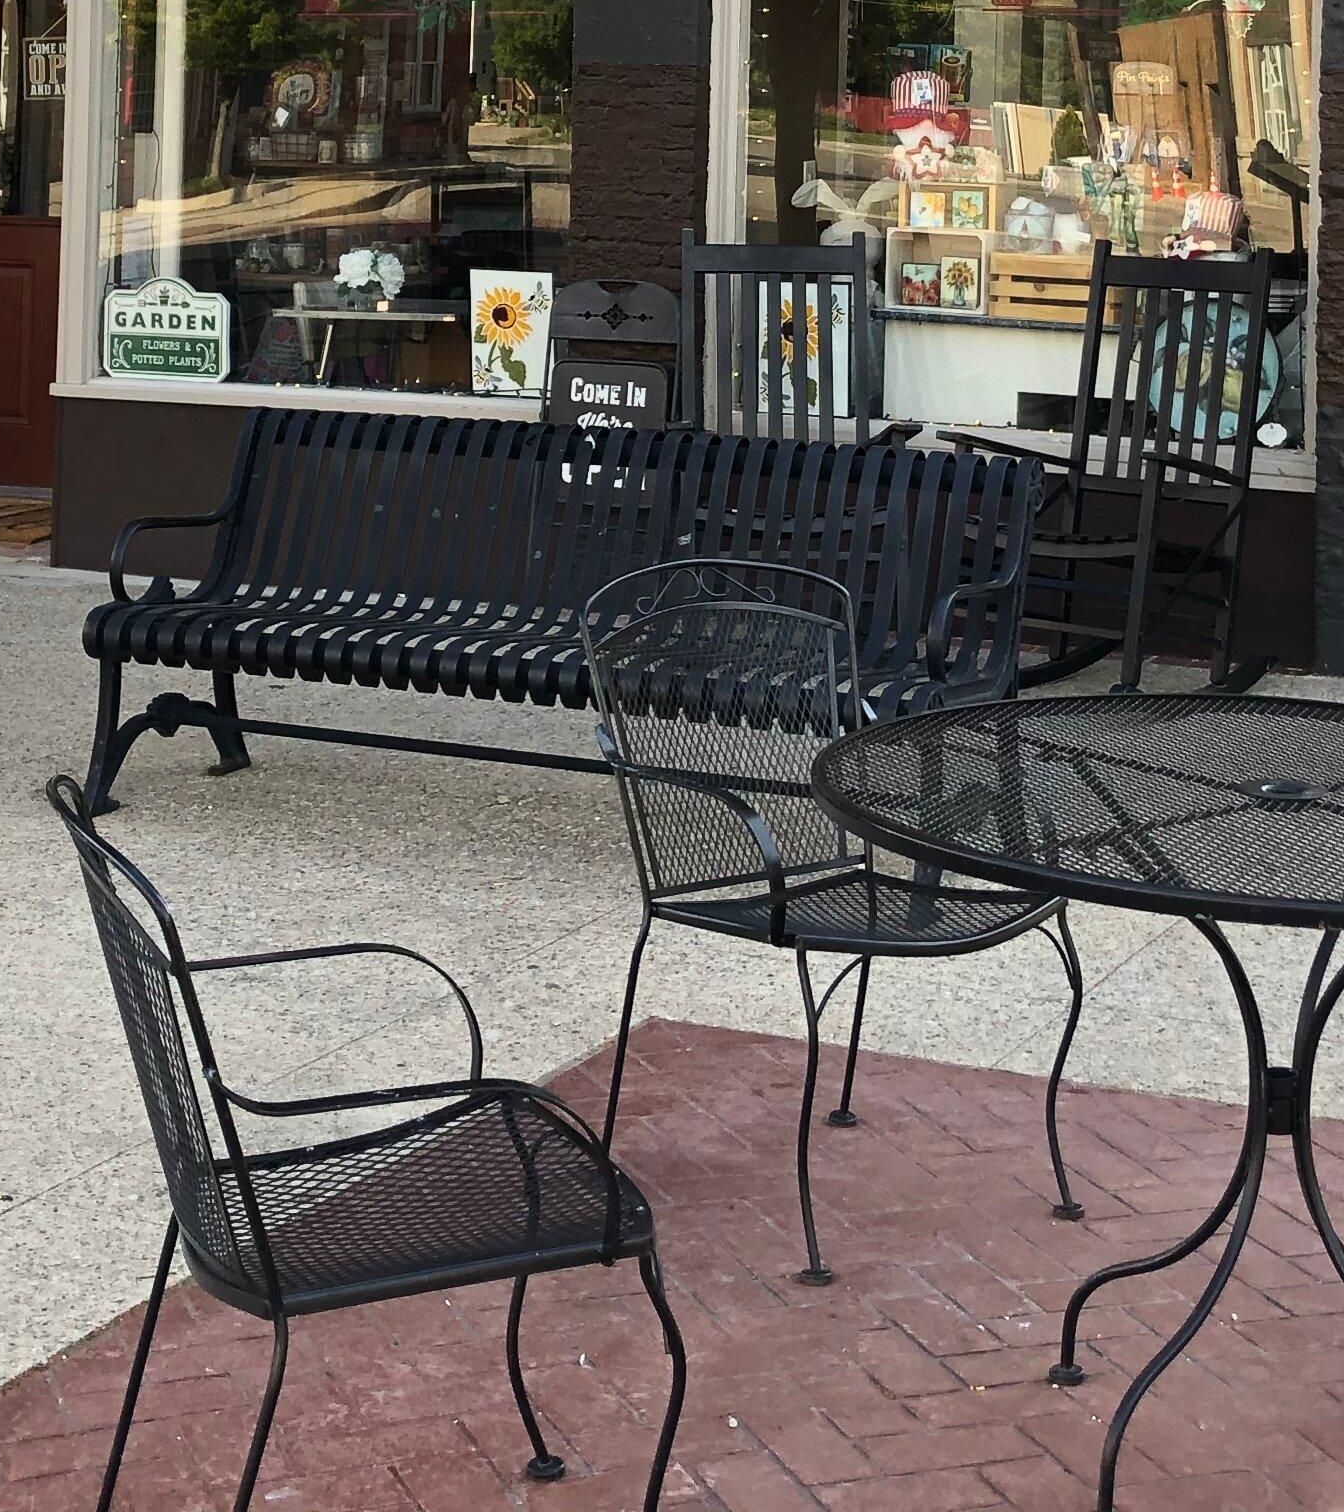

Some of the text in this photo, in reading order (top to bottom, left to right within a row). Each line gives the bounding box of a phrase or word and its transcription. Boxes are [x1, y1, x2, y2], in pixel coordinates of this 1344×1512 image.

[29, 43, 57, 55] COME
[29, 54, 66, 85] OP
[30, 84, 51, 96] AND
[114, 311, 216, 331] GARDEN
[142, 339, 192, 352] FLOWERS &
[131, 353, 202, 367] POTTED PLANTS
